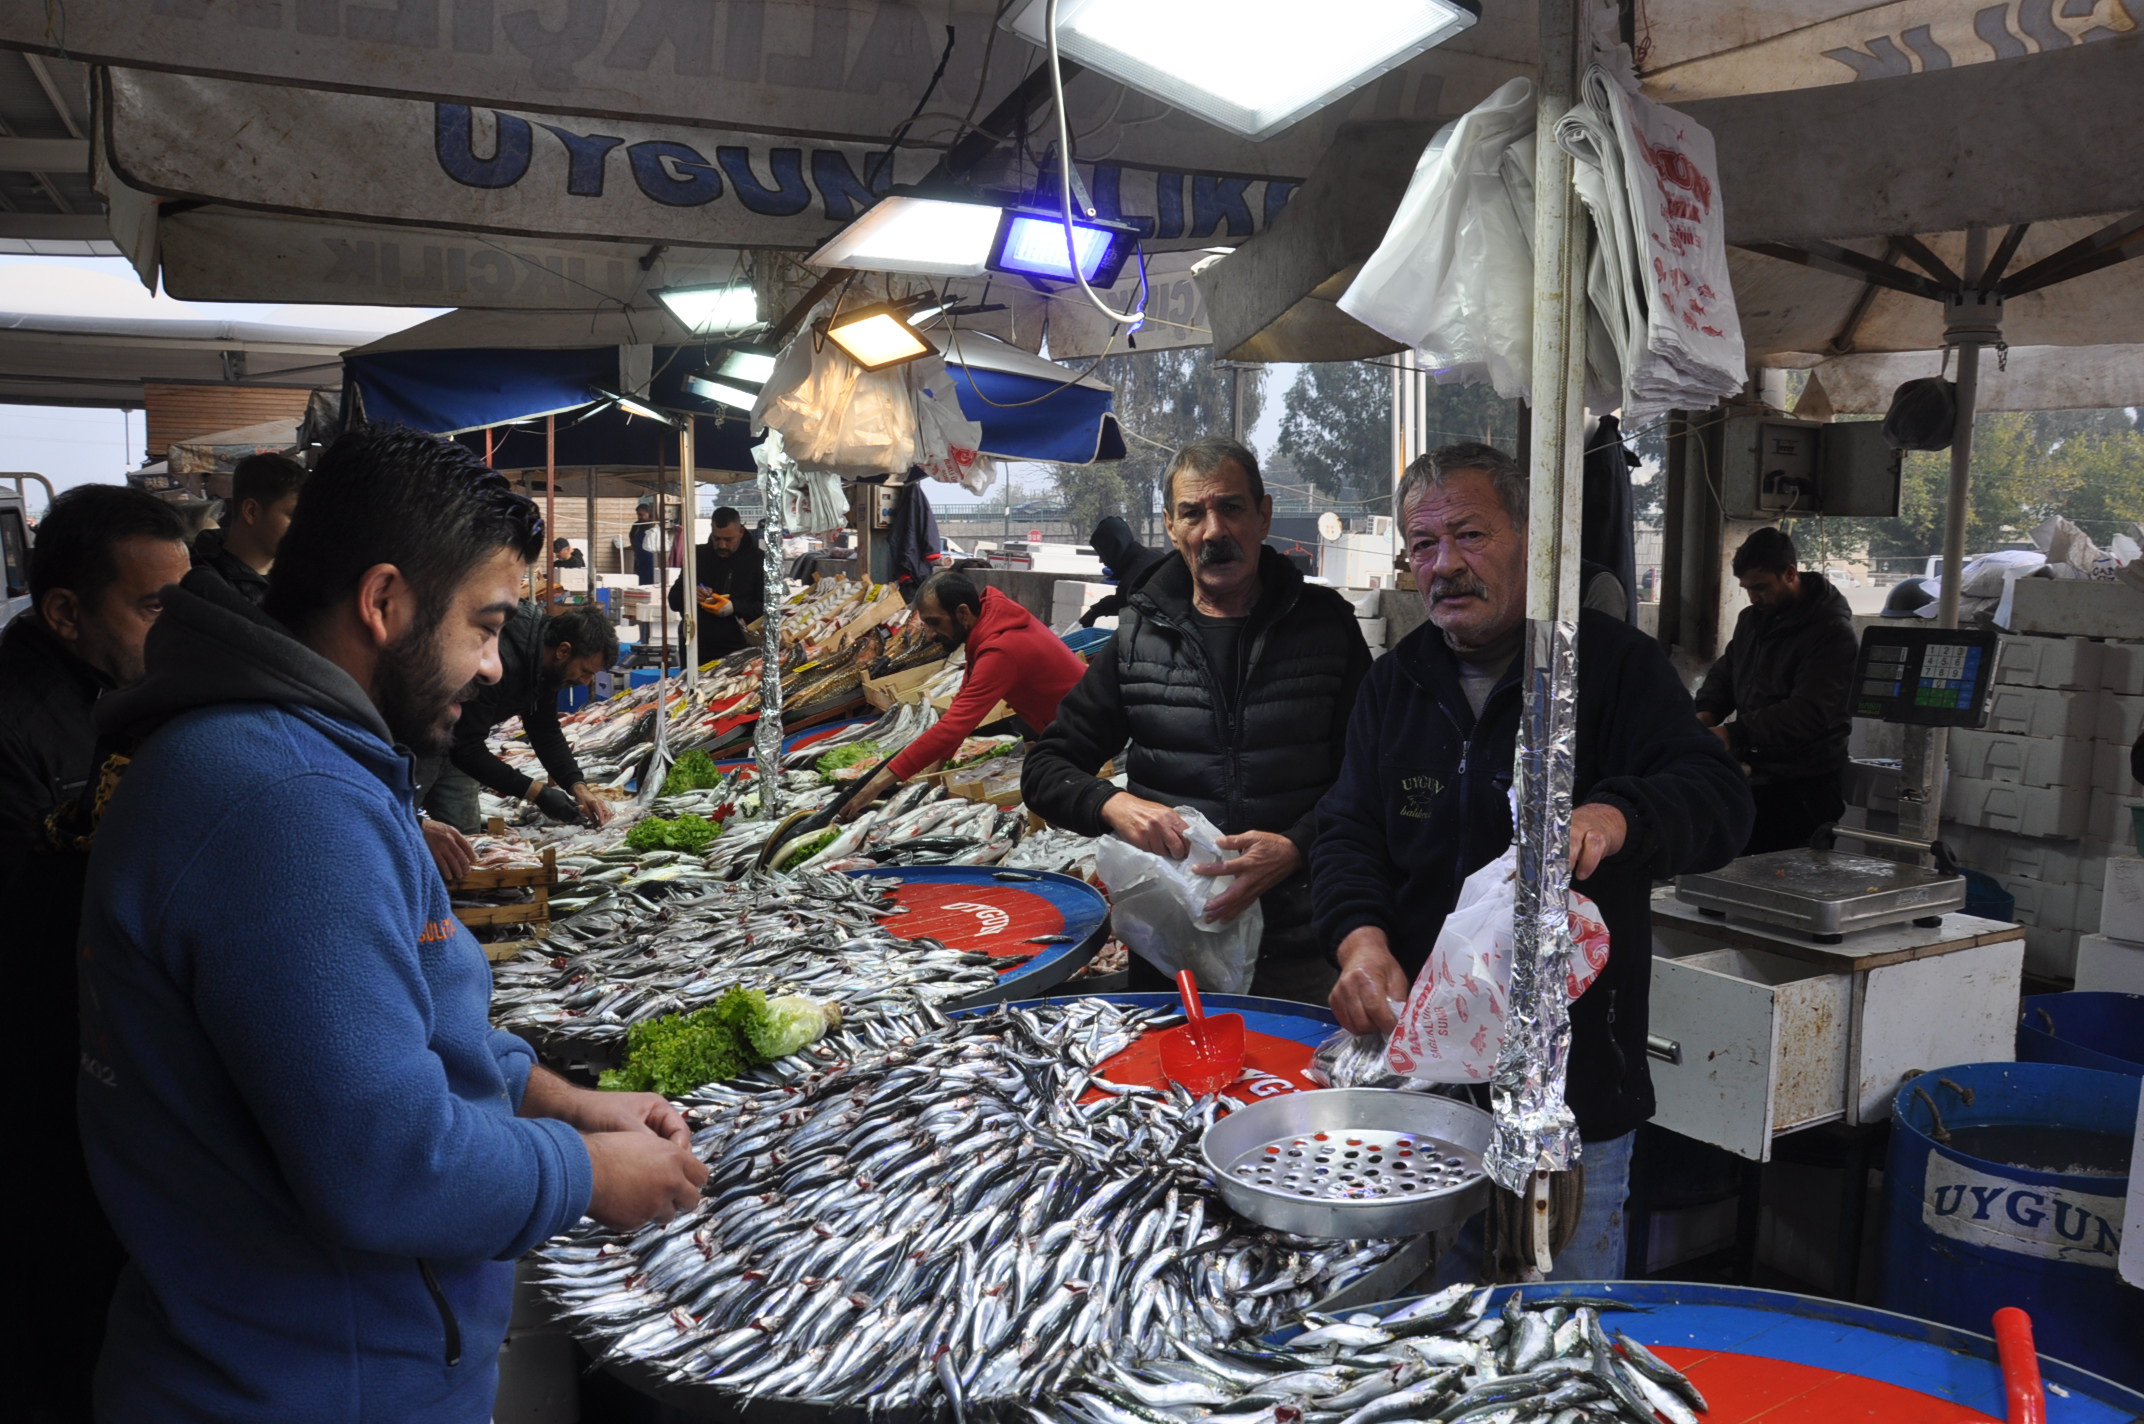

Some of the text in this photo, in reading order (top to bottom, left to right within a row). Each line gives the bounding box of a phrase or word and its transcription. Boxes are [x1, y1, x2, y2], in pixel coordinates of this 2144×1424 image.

[435, 105, 892, 222] UYGUN
[1401, 775, 1444, 794] UYGUN
[940, 902, 1010, 937] UYGUN
[1934, 1184, 2121, 1253] UYGUN
